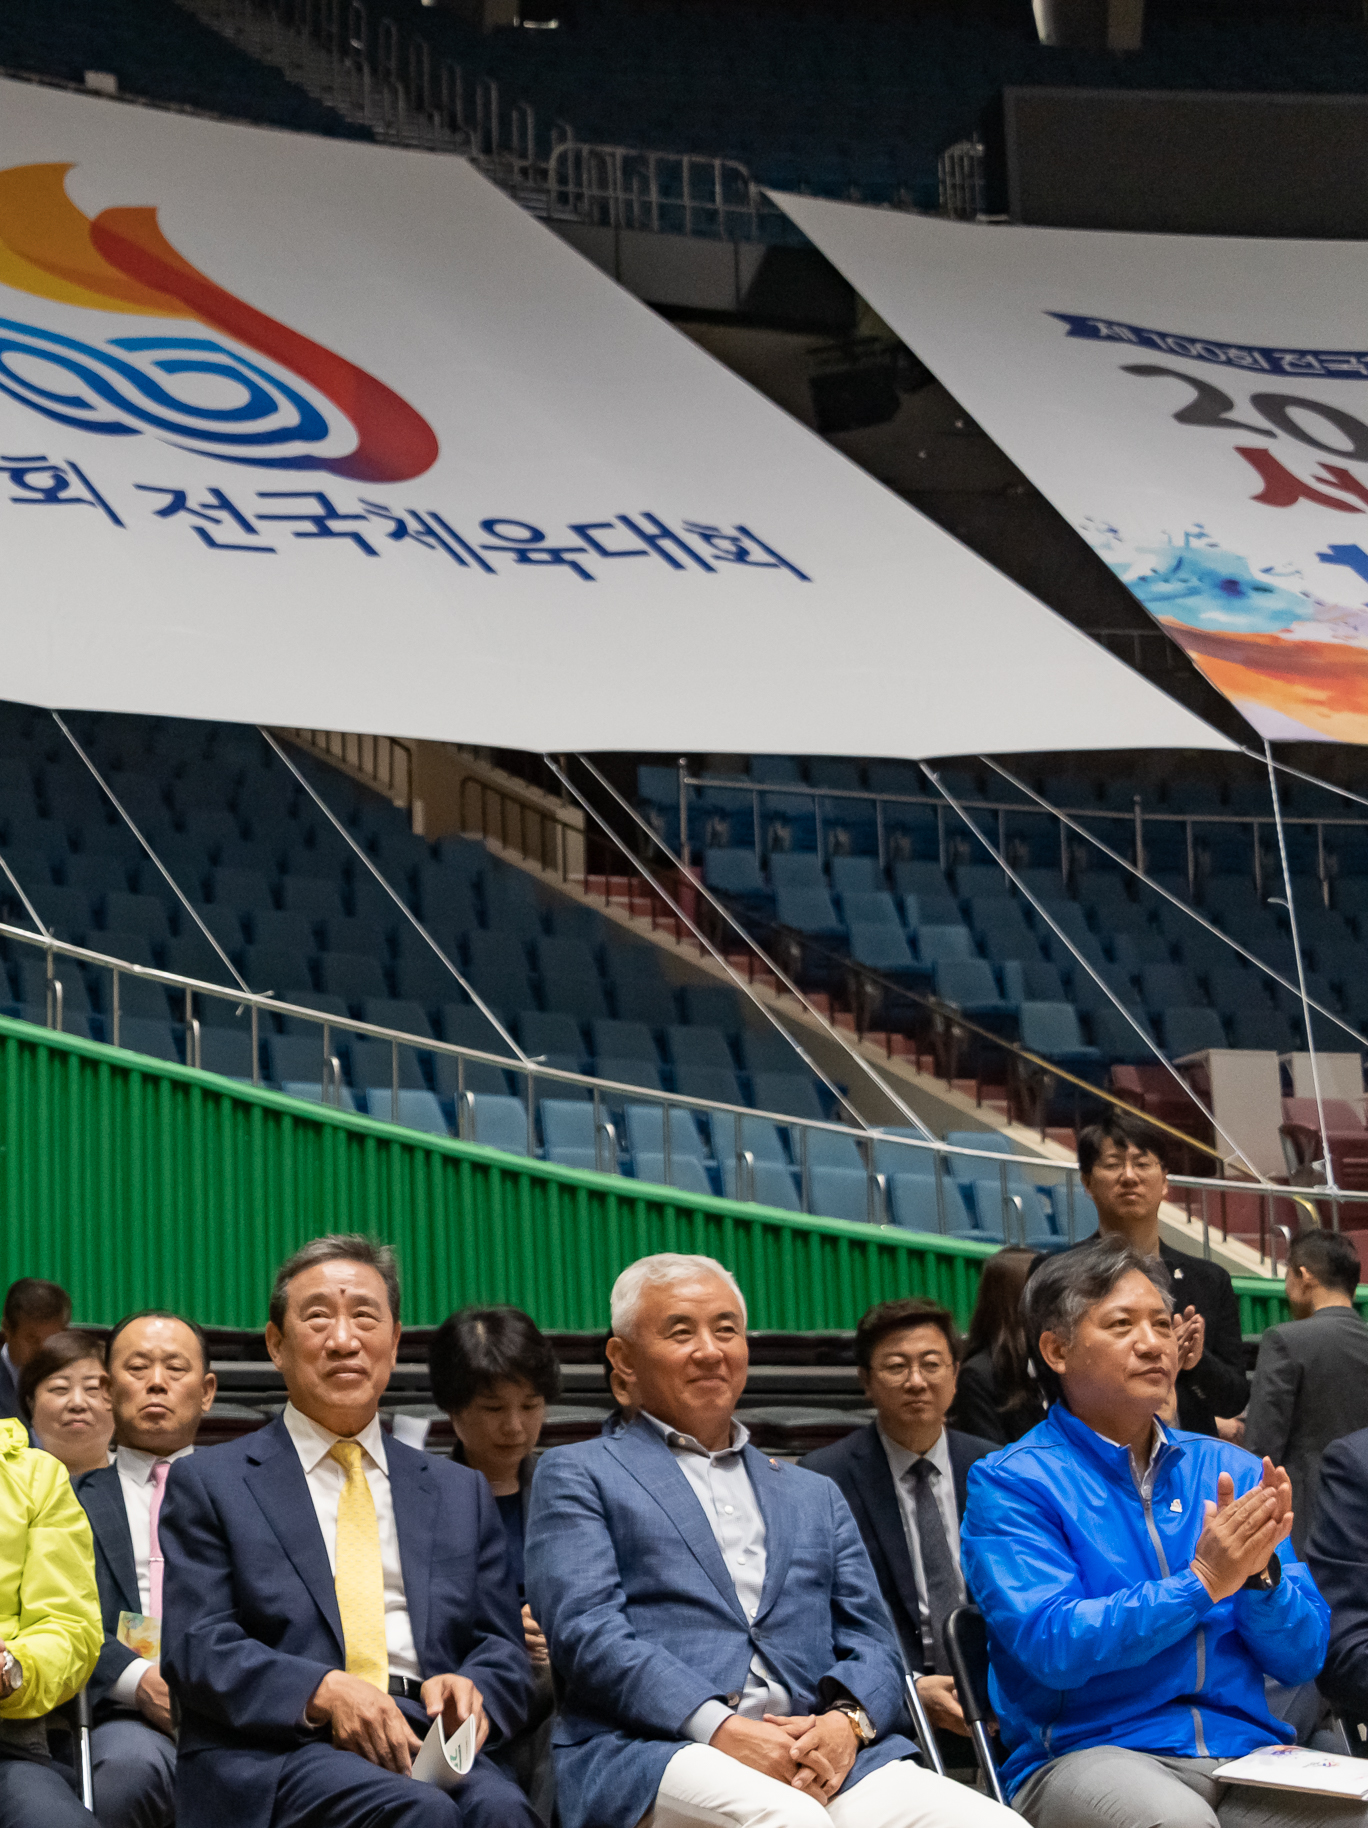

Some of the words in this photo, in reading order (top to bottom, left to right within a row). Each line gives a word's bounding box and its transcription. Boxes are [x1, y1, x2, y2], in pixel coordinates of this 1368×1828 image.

[1087, 319, 1140, 344] 제
[1142, 331, 1271, 371] 100회
[1273, 351, 1368, 377] 전국
[133, 483, 814, 582] 전국체육대회
